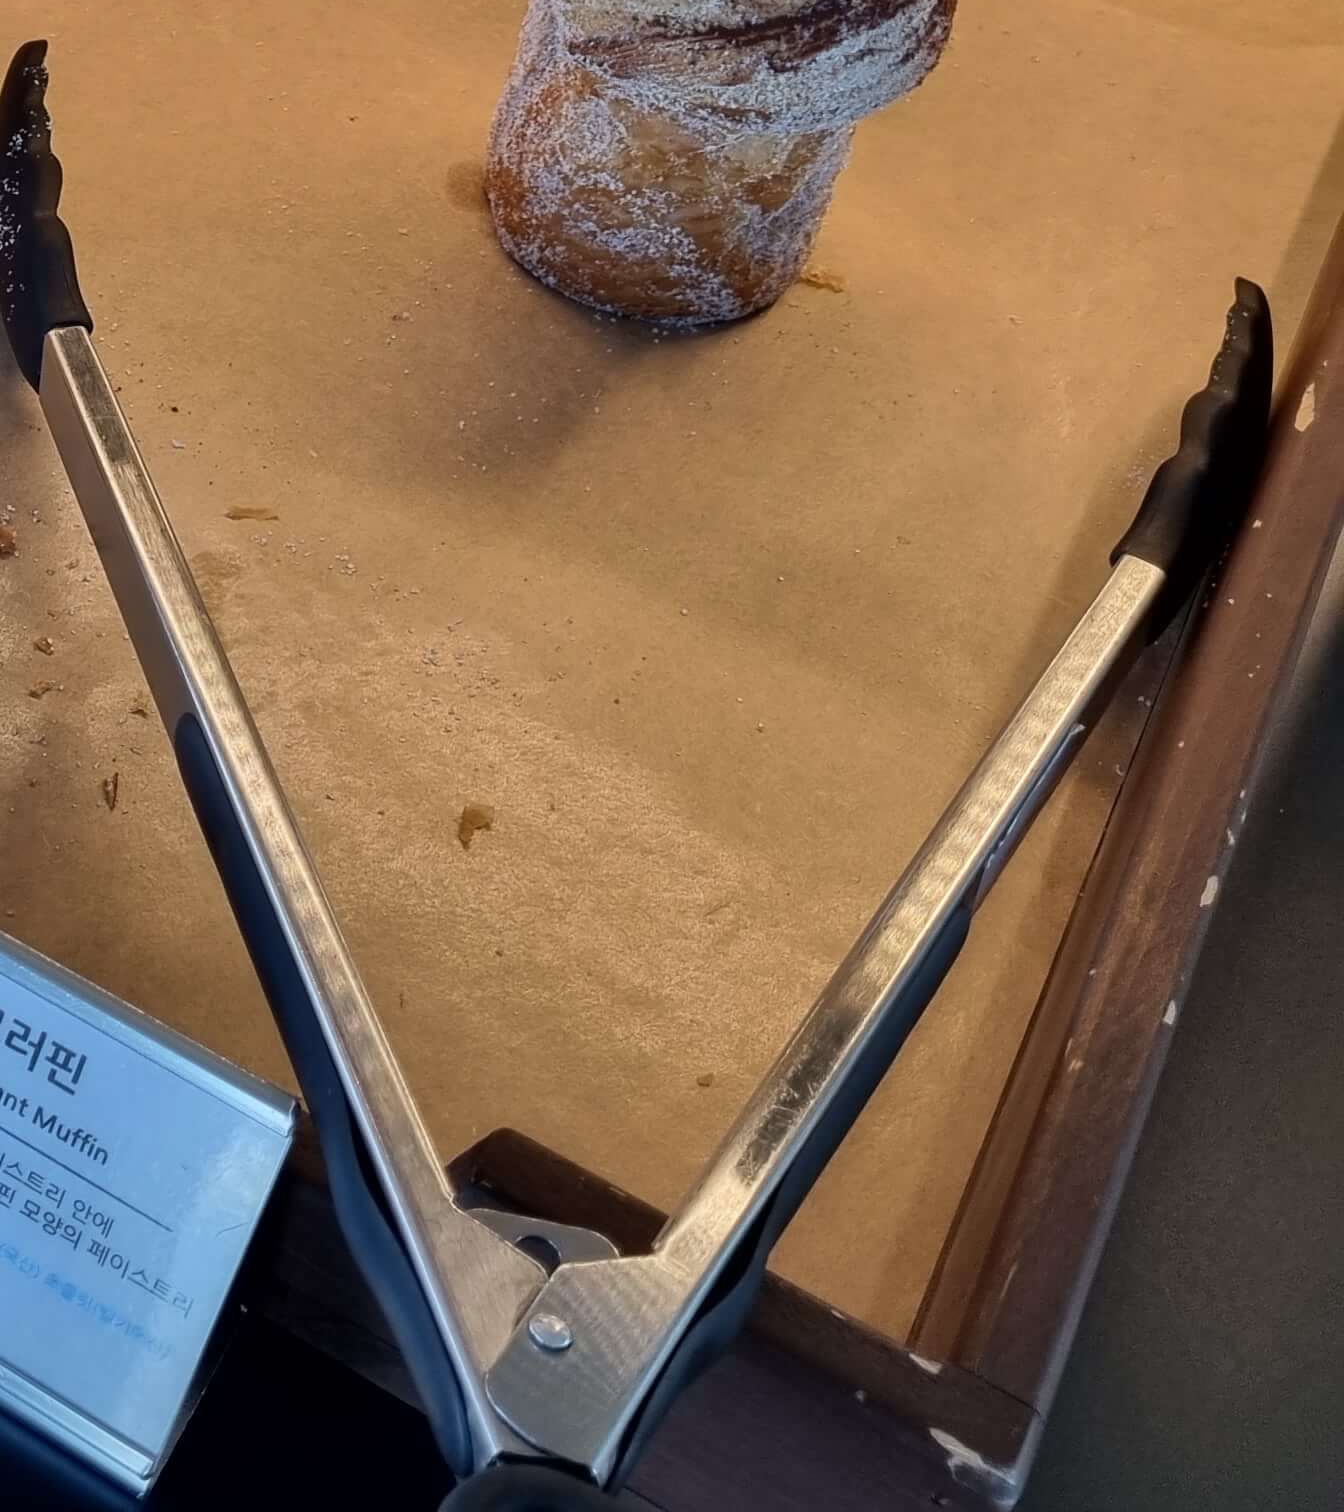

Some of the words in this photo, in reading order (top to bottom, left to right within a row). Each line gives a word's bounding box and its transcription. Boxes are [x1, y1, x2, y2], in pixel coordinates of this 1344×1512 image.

[32, 1106, 108, 1166] Muffin
[71, 1199, 115, 1239] 안에
[18, 1199, 83, 1251] 모양의
[87, 1239, 194, 1319] 페이스트리
